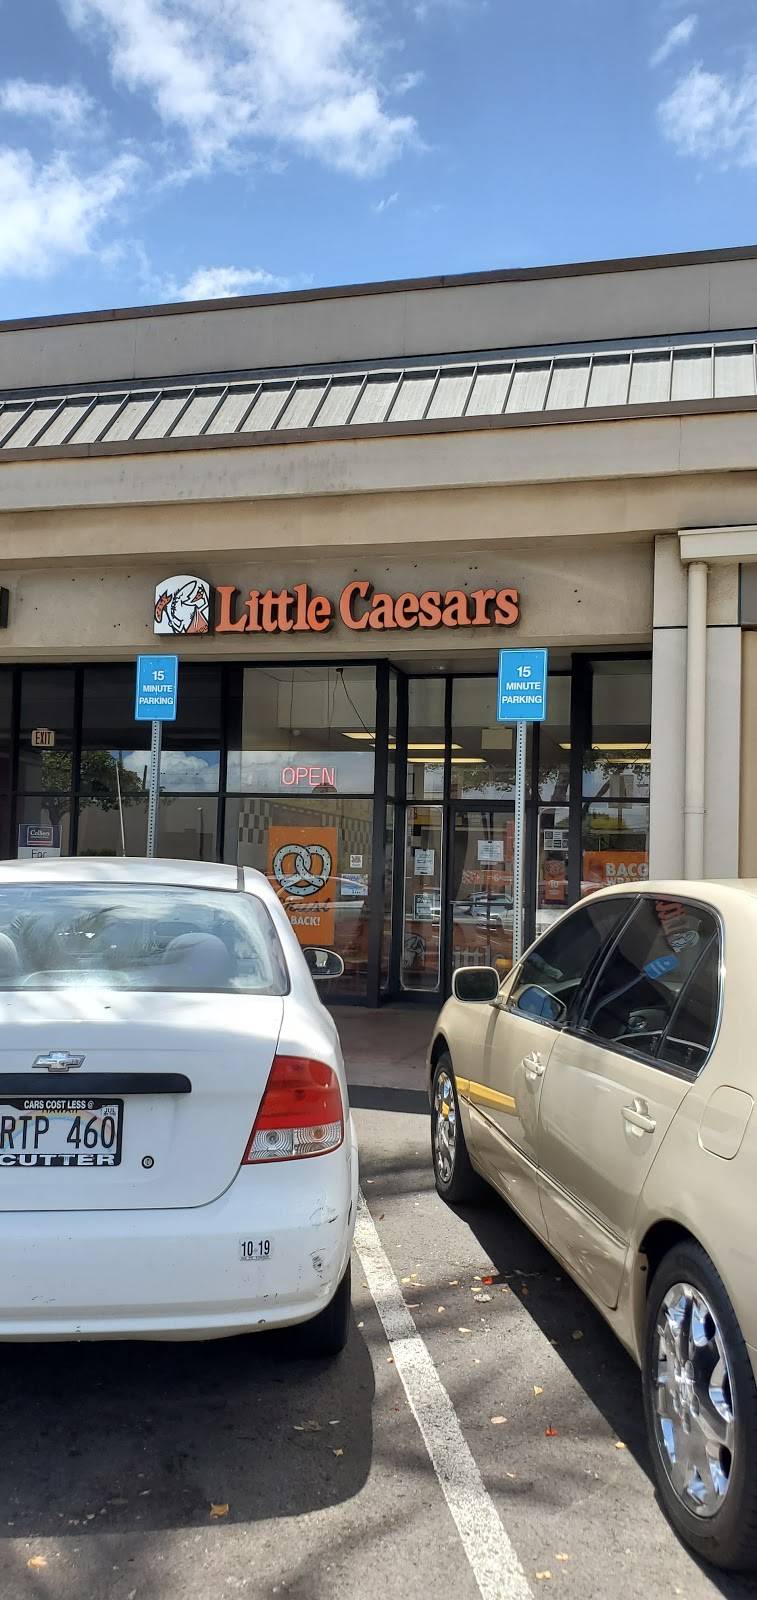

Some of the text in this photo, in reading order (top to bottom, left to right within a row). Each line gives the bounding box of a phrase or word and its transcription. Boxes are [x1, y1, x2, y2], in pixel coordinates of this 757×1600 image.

[214, 581, 520, 632] Little Caesars
[151, 670, 165, 681] 15
[516, 665, 532, 678] 15
[143, 684, 173, 692] MINUTE
[505, 681, 542, 690] MINUTE
[139, 697, 174, 705] PARKING
[501, 695, 543, 704] PARKING
[35, 731, 51, 745] EXIT
[281, 766, 335, 786] OPEN
[289, 915, 321, 926] BACK!
[23, 1100, 44, 1109] CARS
[45, 1100, 66, 1109] COST
[67, 1100, 87, 1109] LESS
[0, 1115, 116, 1150] RTP 460
[0, 1154, 116, 1166] CUTTER
[241, 1239, 271, 1257] 10 19
